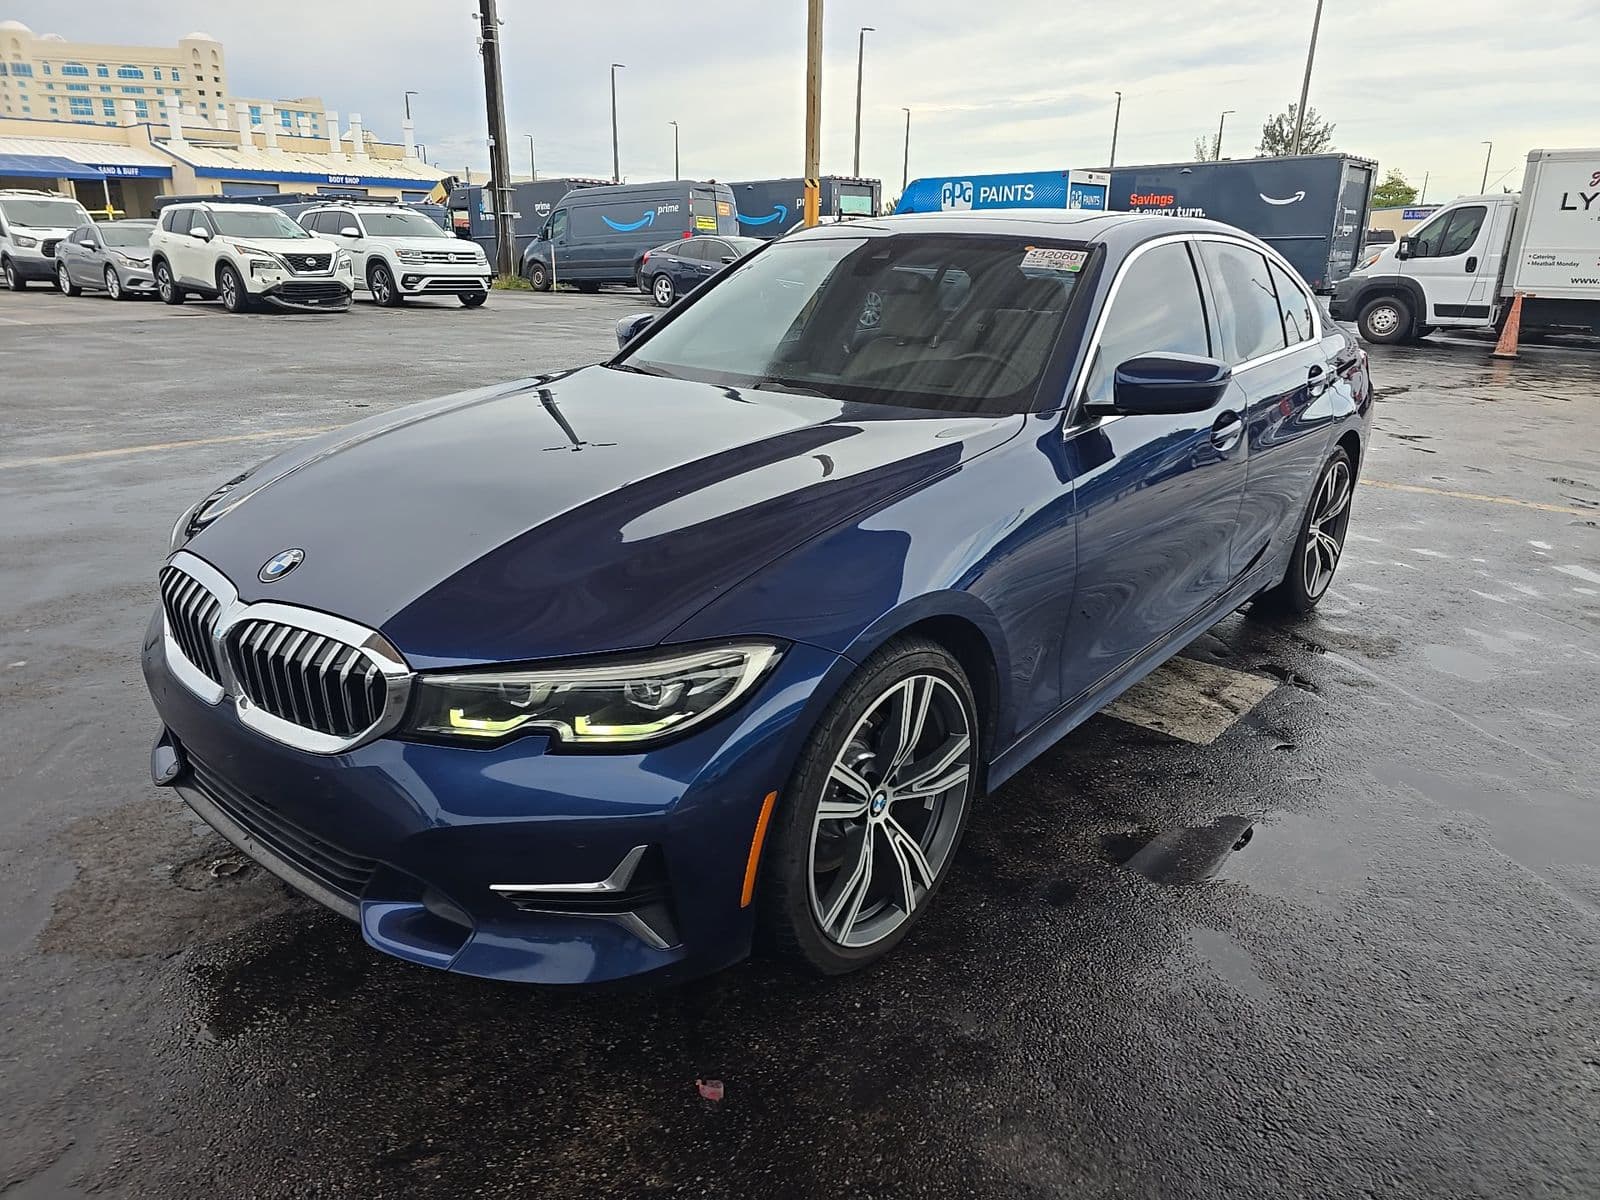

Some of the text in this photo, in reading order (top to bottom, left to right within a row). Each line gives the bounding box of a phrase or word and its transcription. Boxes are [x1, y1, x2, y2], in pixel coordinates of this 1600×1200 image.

[328, 175, 360, 184] BODY SHOP
[942, 182, 1034, 209] PPG PAINTS
[1082, 194, 1100, 206] PAINTS
[1130, 193, 1174, 207] Savings
[534, 201, 551, 212] prime
[657, 203, 679, 216] prime
[1142, 208, 1175, 217] every
[1176, 206, 1206, 217] turn.
[1532, 253, 1556, 261] Catering
[1556, 260, 1580, 268] Monday
